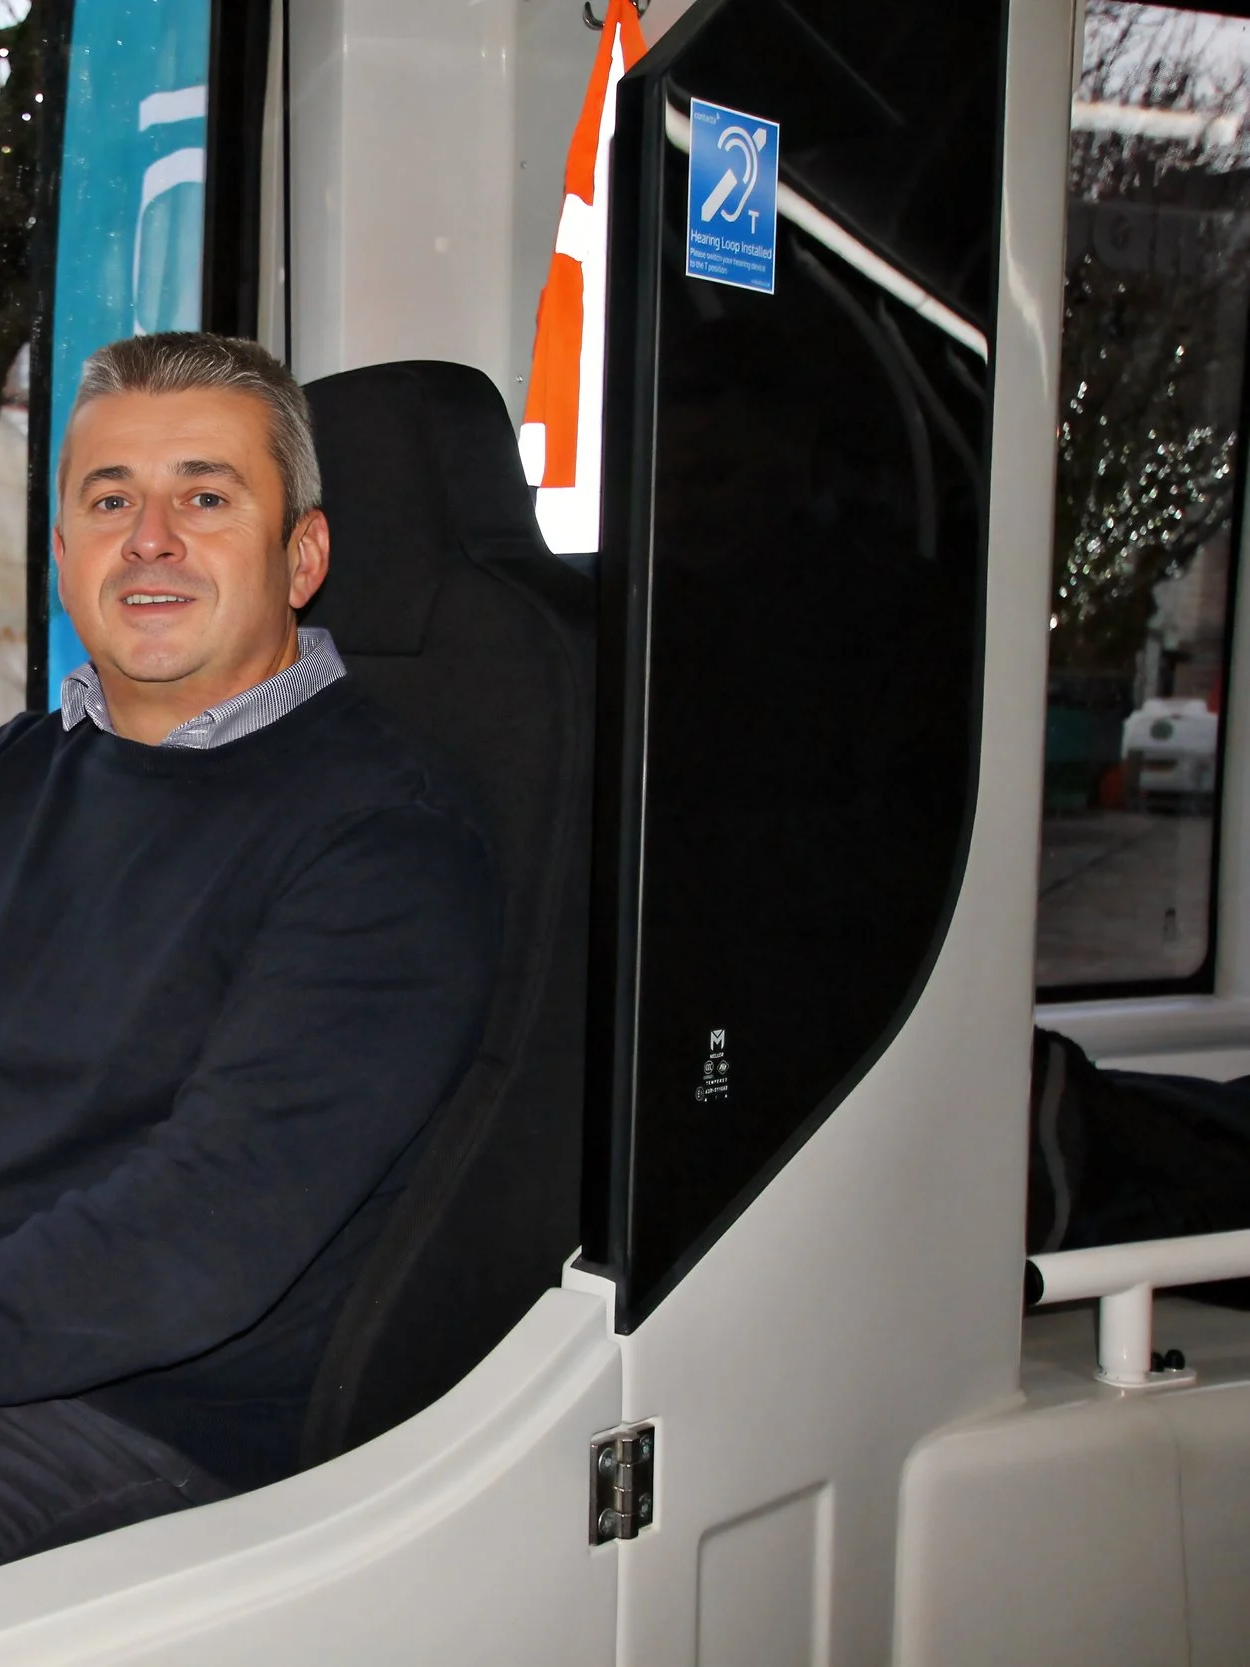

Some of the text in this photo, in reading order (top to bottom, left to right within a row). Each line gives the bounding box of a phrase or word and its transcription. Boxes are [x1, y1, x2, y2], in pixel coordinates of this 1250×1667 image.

[748, 210, 759, 234] T
[690, 229, 772, 260] Hearing Loop Installed
